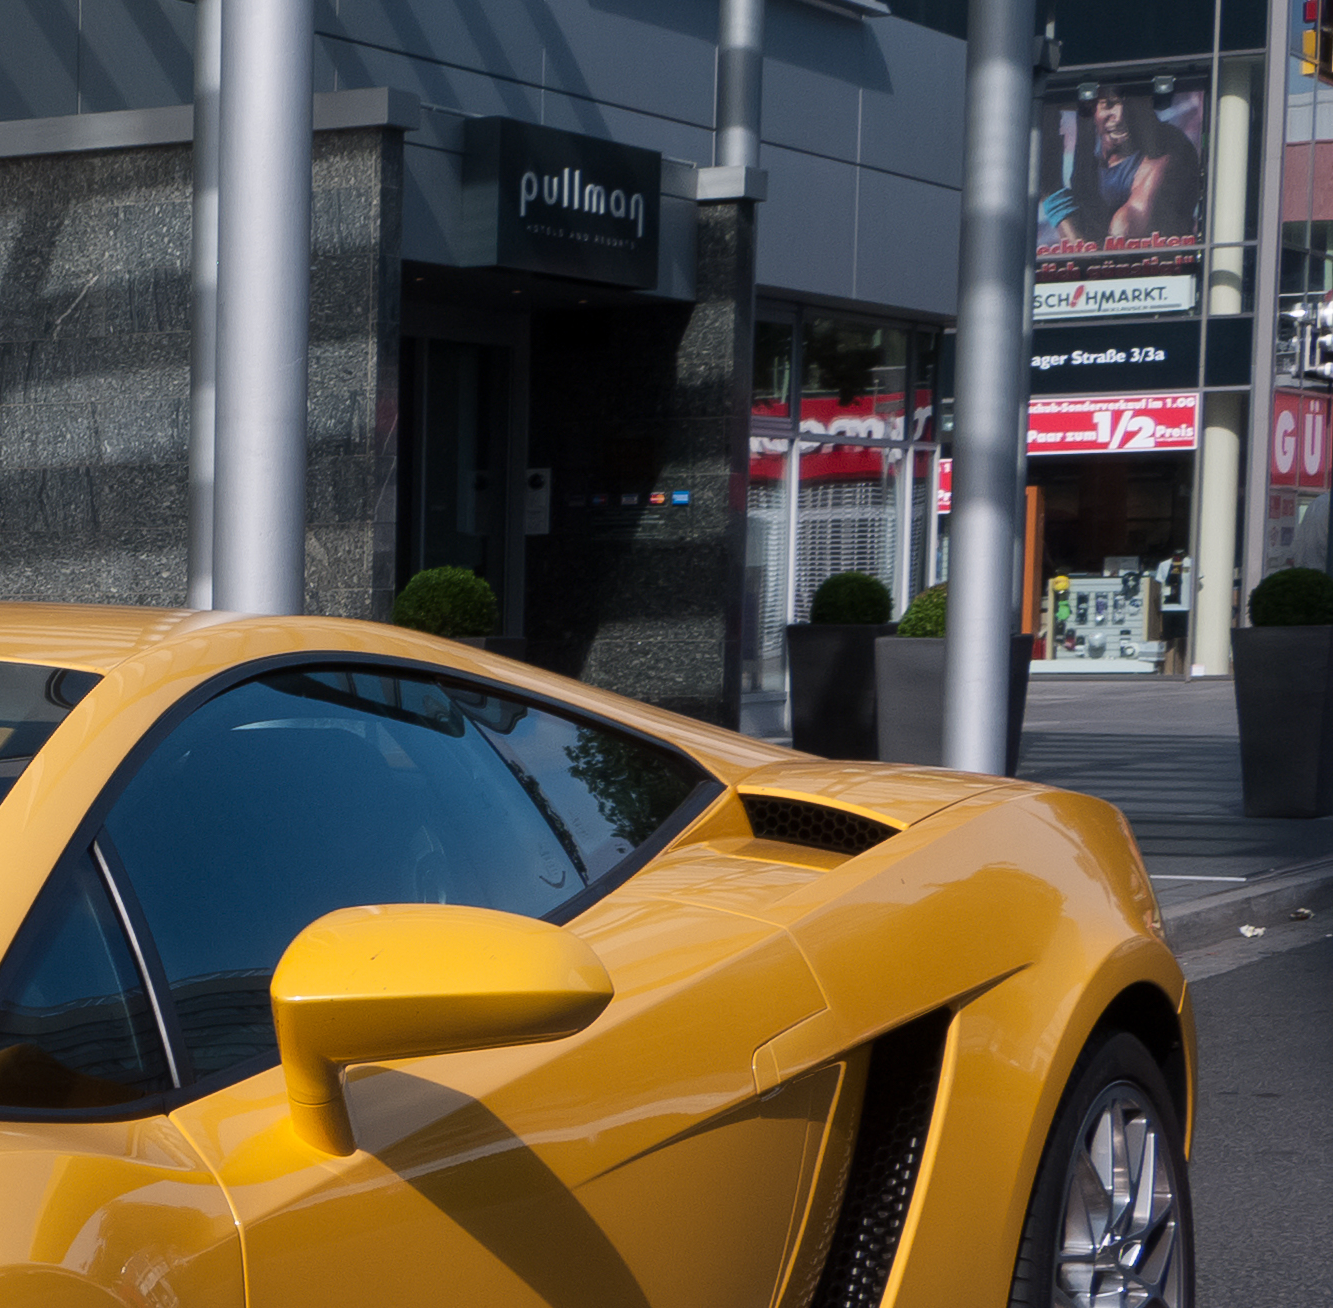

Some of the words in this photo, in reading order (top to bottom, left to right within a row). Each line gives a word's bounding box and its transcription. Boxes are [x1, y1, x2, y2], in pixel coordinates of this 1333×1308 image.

[520, 167, 643, 238] pullman
[1104, 231, 1196, 251] Marken
[1030, 353, 1068, 369] ager
[1071, 349, 1126, 365] Straße
[1129, 347, 1165, 363] 3/3a
[1027, 429, 1063, 443] Paar
[1065, 431, 1097, 441] zum
[1093, 410, 1156, 450] 1/2
[1155, 424, 1194, 438] Preis
